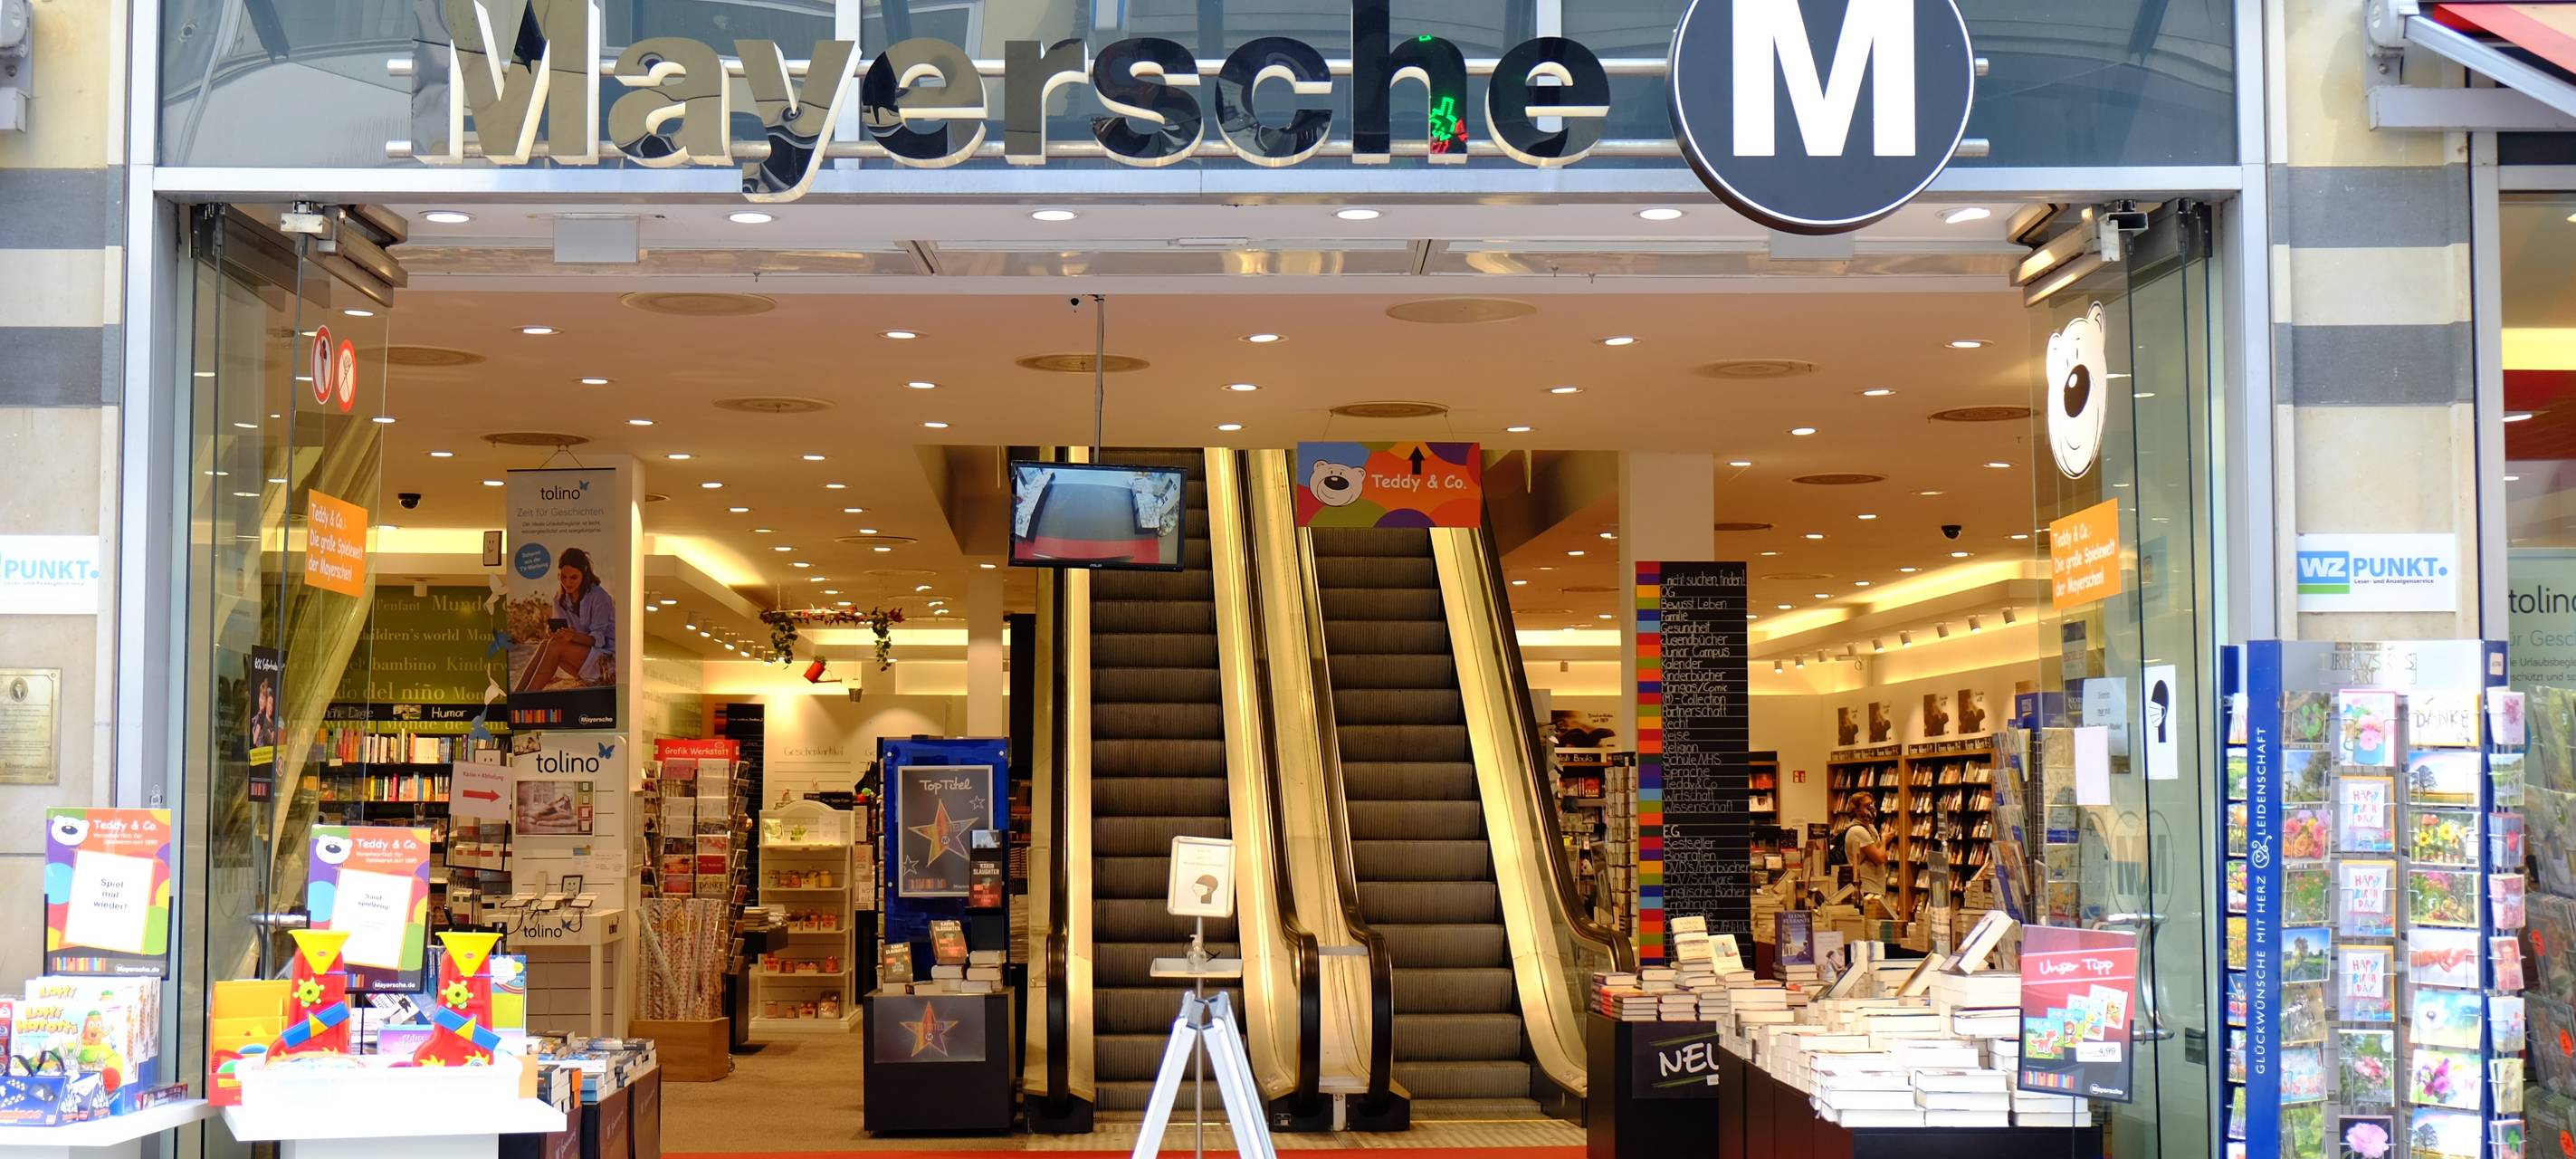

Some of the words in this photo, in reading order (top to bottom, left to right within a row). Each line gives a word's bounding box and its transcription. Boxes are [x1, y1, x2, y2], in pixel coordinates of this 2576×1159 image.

[1732, 0, 1916, 157] M
[412, 0, 1610, 202] Mayersche
[1370, 474, 1421, 493] Teddy
[1426, 474, 1438, 489] &
[1445, 474, 1467, 489] Co.
[540, 485, 580, 501] tolino
[310, 503, 329, 530] Teddy
[329, 510, 335, 526] &
[517, 507, 533, 517] Zeit
[536, 507, 548, 517] für
[550, 507, 605, 517] Geschichten
[2053, 529, 2072, 550] Teddy
[2073, 524, 2079, 542] &
[310, 528, 320, 547] Die
[320, 533, 336, 554] große
[337, 538, 364, 560] Spielewelt
[2054, 557, 2066, 574] Die
[2066, 551, 2083, 575] große
[2085, 537, 2115, 568] Spielewelt
[308, 554, 320, 572] der
[2300, 557, 2346, 578] WZ
[1660, 587, 1675, 598] OG
[2056, 580, 2066, 598] der
[1660, 598, 1694, 609] Bewusst
[1697, 598, 1728, 609] Leben
[1661, 610, 1688, 621] Familie
[1661, 621, 1710, 633] Gesundheit
[423, 627, 460, 641] world
[1660, 633, 1728, 646] Jugendbücher
[2530, 629, 2576, 647] Gesc
[1660, 646, 1689, 657] Junior
[1692, 646, 1730, 659] Campus
[372, 656, 436, 671] bambino
[1661, 657, 1703, 669] Kalender
[1661, 669, 1726, 681] Kinderbücher
[2547, 673, 2563, 681] und
[401, 683, 445, 700] niño
[431, 706, 468, 719] Humor
[1663, 704, 1727, 717] Partnerschaft
[579, 715, 614, 724] Mayersche
[1663, 717, 1689, 729] Recht
[2416, 709, 2470, 729] DANKE
[1663, 729, 1690, 741] Reise
[664, 746, 688, 754] Grafik
[690, 747, 729, 755] Werkstatt
[1663, 741, 1699, 754] Religion
[536, 751, 599, 773] tolino
[1664, 765, 1711, 780] Sprache
[2256, 727, 2267, 835] LEIDENSCHAFT
[1662, 789, 1713, 801] Wirtschaft
[1662, 800, 1733, 813] Wissenschaft
[92, 819, 127, 832] Teddy
[130, 820, 139, 831] &
[143, 820, 159, 831] Co.
[1663, 825, 1681, 838] EG
[357, 838, 388, 851] Teddy
[392, 839, 400, 849] &
[404, 839, 419, 849] Co.
[1664, 837, 1716, 849] Bestseller
[1664, 848, 1717, 862] Biografien
[100, 878, 124, 888] Spiel
[1664, 885, 1713, 898] Englische
[1715, 885, 1746, 897] Bücher
[2256, 875, 2267, 912] HERZ
[1664, 896, 1718, 908] Ernährung
[524, 924, 563, 938] tolino
[2256, 915, 2266, 943] MIT
[2039, 959, 2080, 975] Unser
[2082, 958, 2114, 975] Tipp
[372, 980, 415, 990] Mayersche.de
[2254, 950, 2266, 1075] GLÜCKWÜNSCHE
